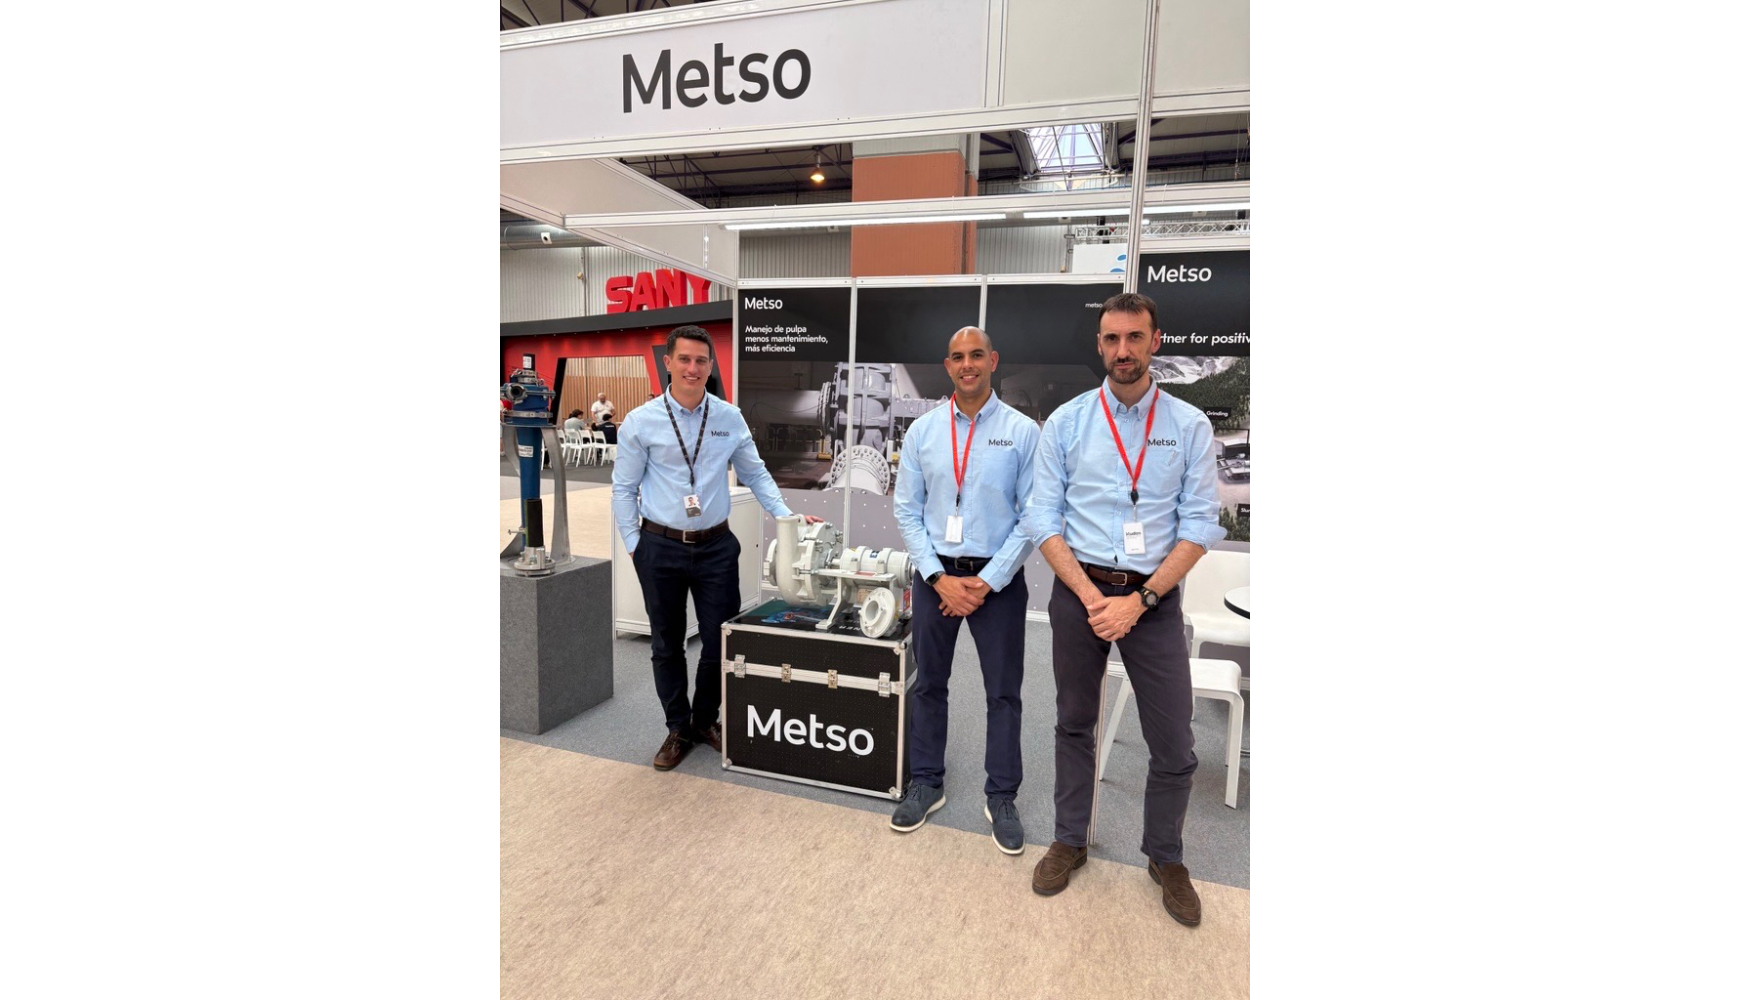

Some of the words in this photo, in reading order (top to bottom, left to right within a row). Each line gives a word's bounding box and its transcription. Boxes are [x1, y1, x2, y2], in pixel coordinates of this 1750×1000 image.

[622, 42, 812, 114] Metso
[1147, 264, 1212, 283] Metso
[605, 268, 712, 315] SANY
[744, 296, 783, 310] Metso
[745, 325, 773, 335] Manejo
[774, 325, 784, 333] de
[785, 324, 807, 335] pulpa
[770, 335, 829, 344] mantenimiento,
[1190, 332, 1209, 344] for
[745, 344, 760, 353] más
[761, 344, 796, 353] eficiencia
[1206, 410, 1229, 418] Grinding
[988, 438, 1014, 447] Metso
[1147, 437, 1177, 447] Metso
[747, 704, 875, 756] Metso
